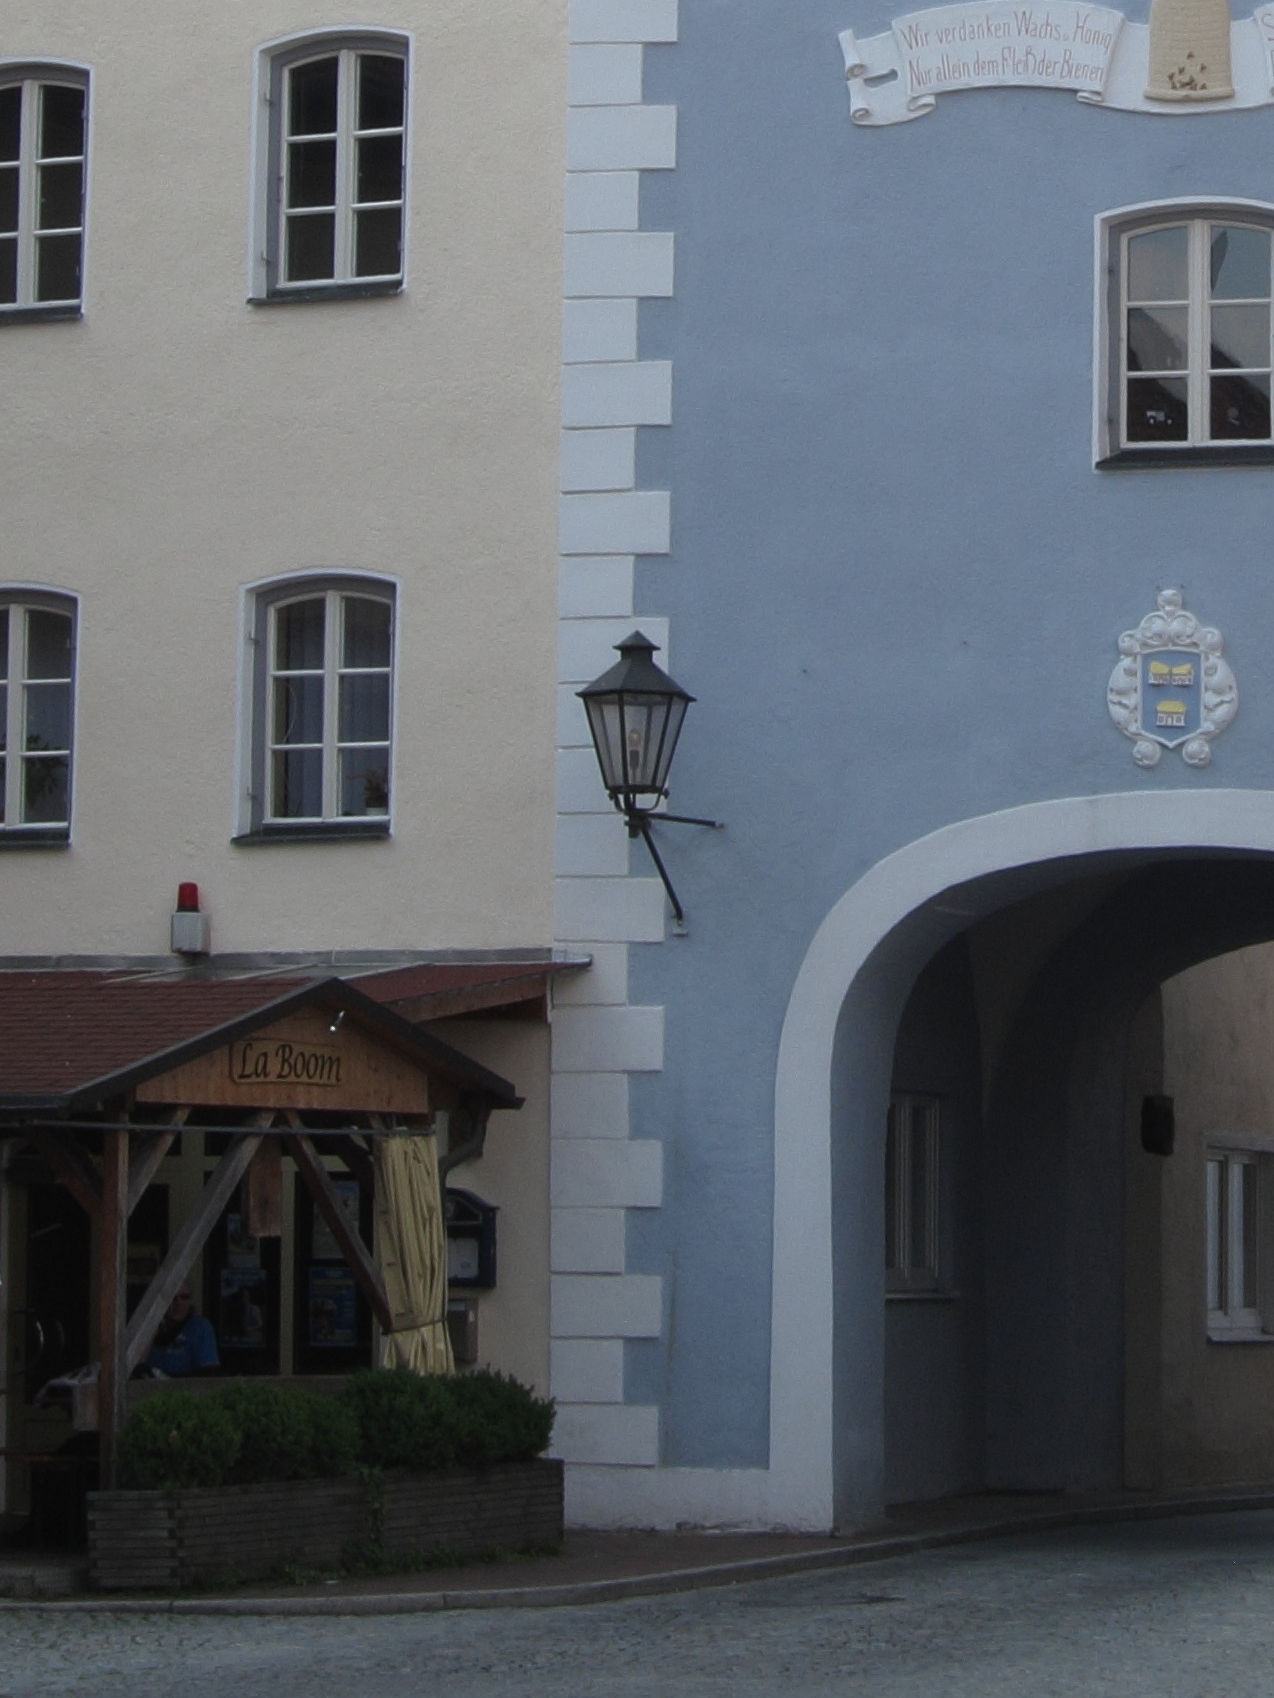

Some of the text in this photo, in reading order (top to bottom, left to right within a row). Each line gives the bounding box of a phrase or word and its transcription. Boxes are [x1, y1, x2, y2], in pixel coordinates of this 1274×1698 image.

[900, 23, 929, 50] Wir
[935, 15, 1011, 44] verdanken
[1013, 10, 1061, 41] Wachs
[1073, 10, 1113, 54] Honig
[908, 55, 932, 93] Nur
[936, 53, 971, 82] allein
[973, 50, 1000, 77] dem
[1037, 48, 1060, 77] der
[1060, 48, 1105, 83] Bienen
[238, 1042, 342, 1082] La Boom
